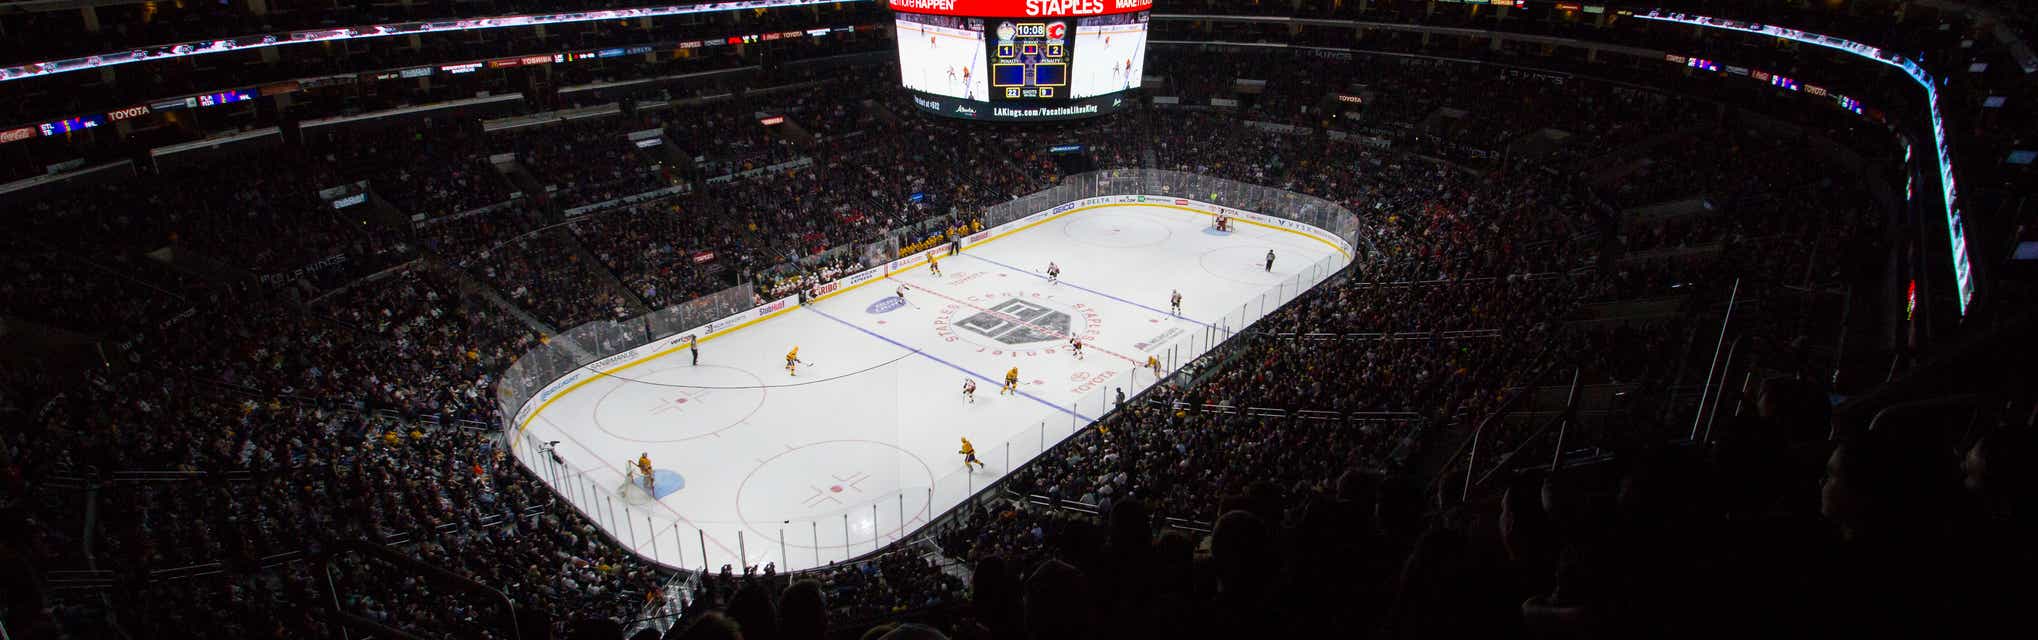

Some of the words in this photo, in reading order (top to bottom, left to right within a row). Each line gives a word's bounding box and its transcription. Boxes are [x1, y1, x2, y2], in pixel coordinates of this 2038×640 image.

[1026, 0, 1104, 15] STAPLES
[1019, 26, 1043, 35] 10:08
[109, 106, 150, 121] TOYOTA
[1052, 203, 1075, 214] GEICO
[1072, 370, 1118, 393] TOYOTA
